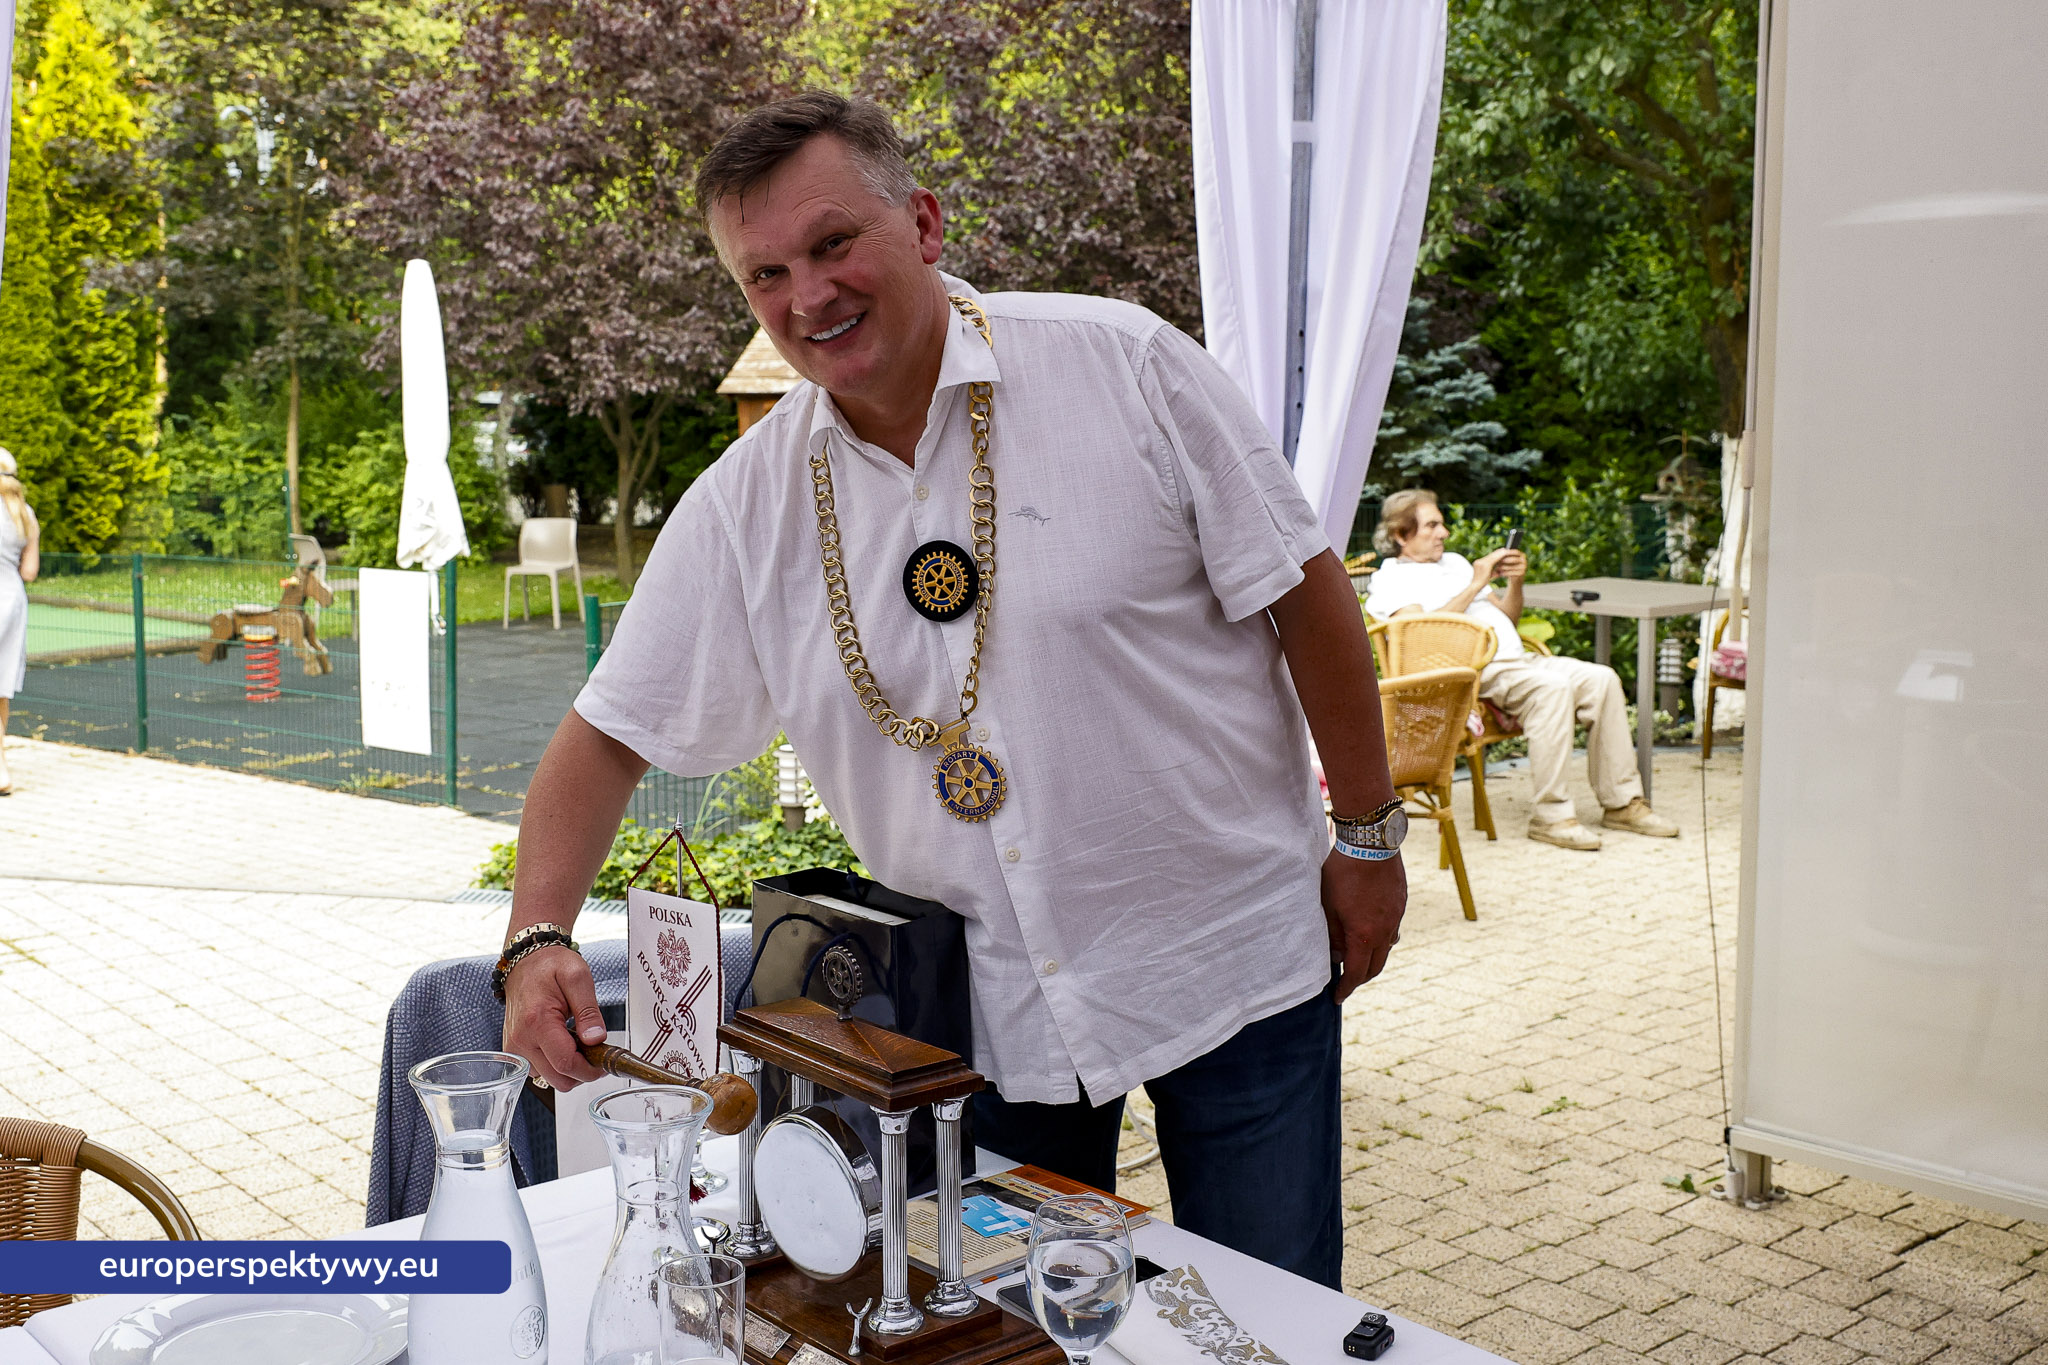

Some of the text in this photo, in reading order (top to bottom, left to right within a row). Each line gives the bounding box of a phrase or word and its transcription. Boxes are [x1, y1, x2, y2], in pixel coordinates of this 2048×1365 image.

[943, 751, 975, 768] ROTARY
[950, 785, 999, 815] INTERNATIONAL
[648, 905, 693, 928] POLSKA
[636, 950, 668, 1006] ROTARY
[671, 1012, 709, 1080] KATOWIC
